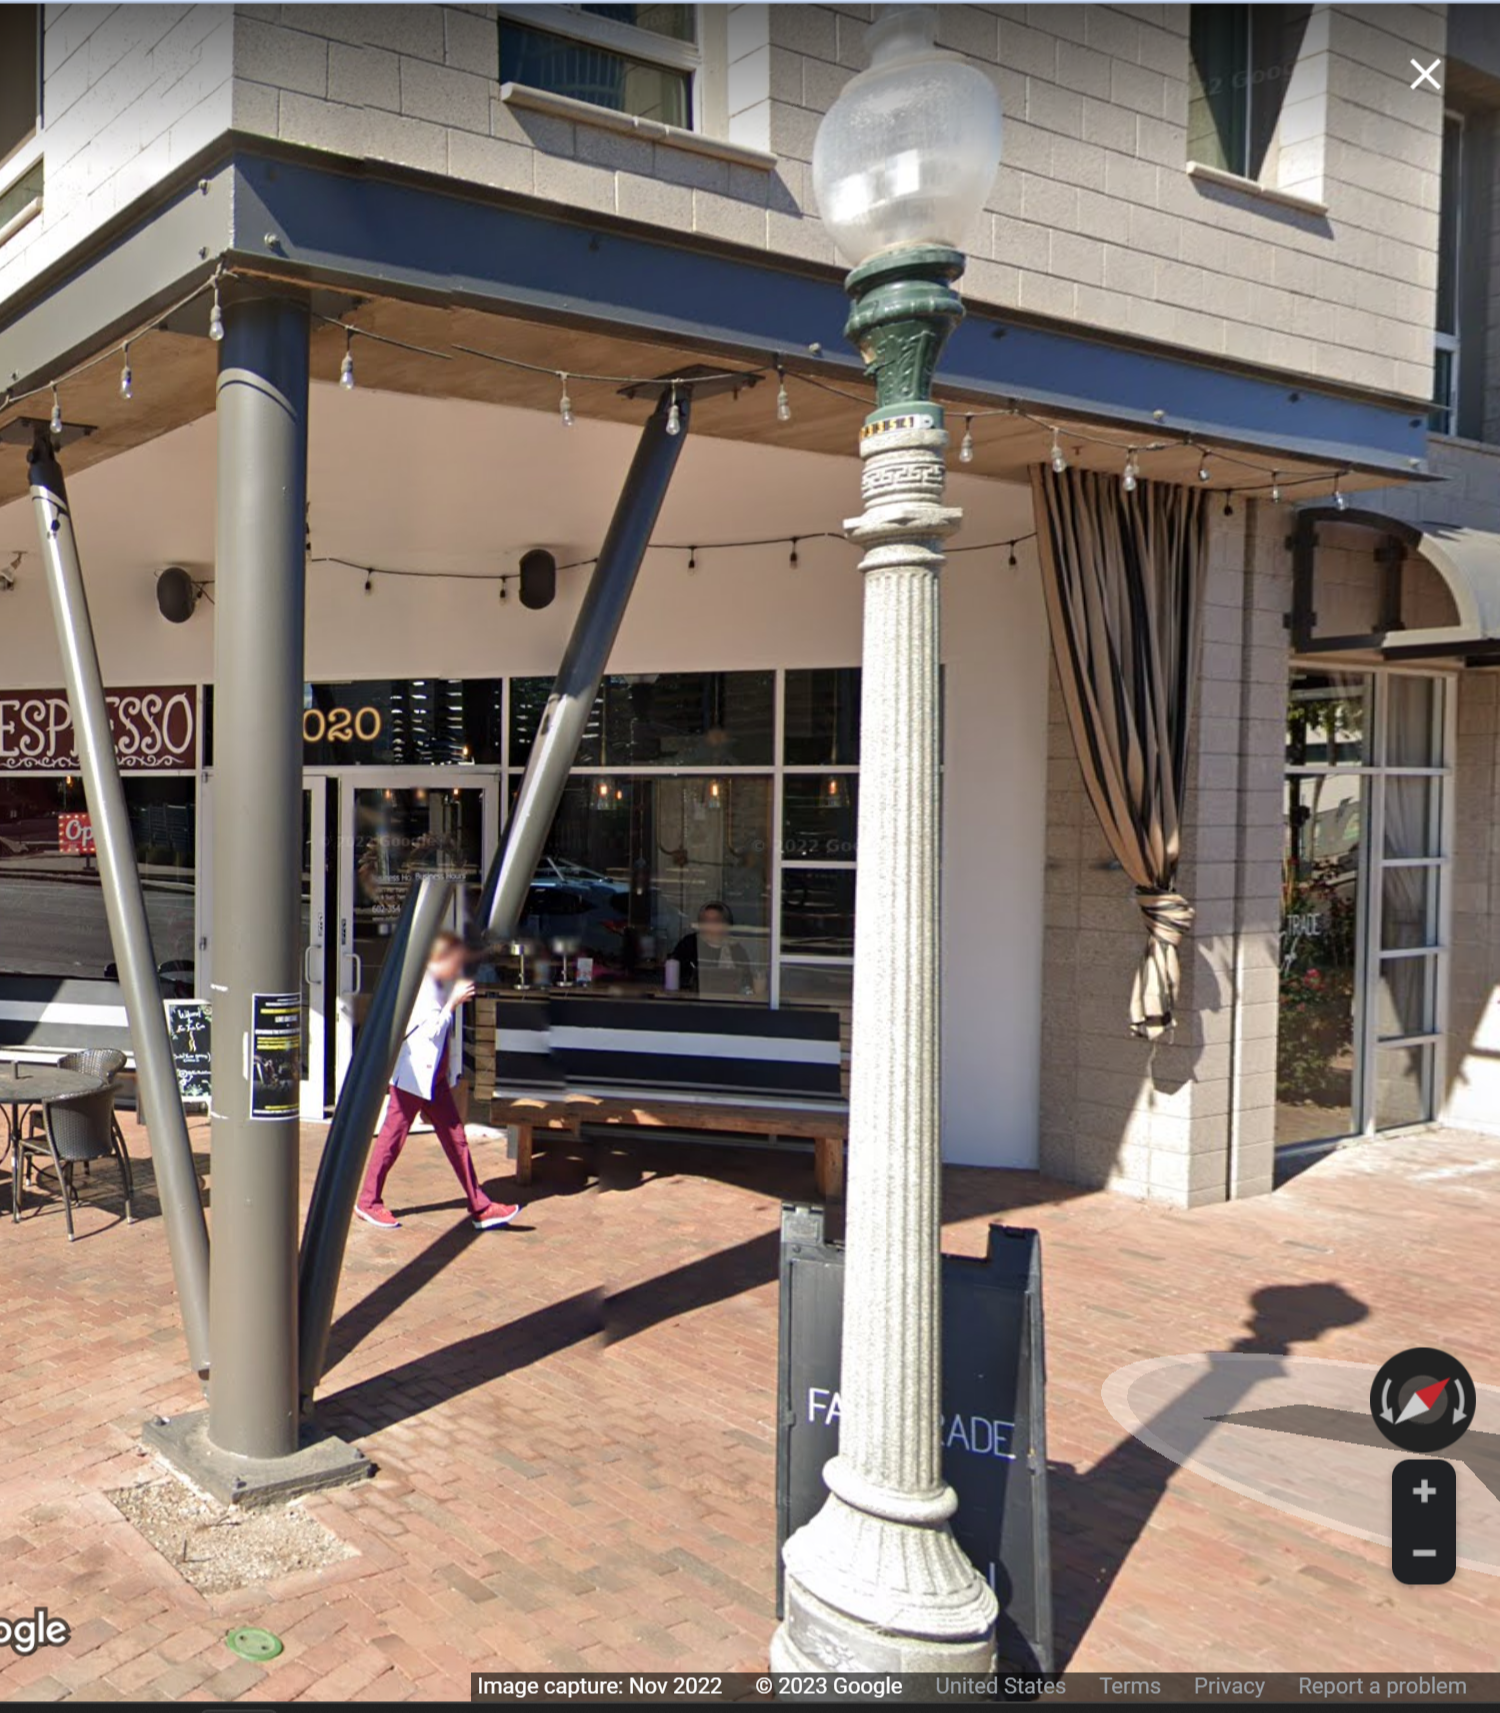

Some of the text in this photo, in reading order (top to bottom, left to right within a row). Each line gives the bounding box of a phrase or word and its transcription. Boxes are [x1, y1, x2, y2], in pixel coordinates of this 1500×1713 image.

[303, 706, 381, 743] 020
[64, 818, 95, 848] Op
[1287, 913, 1322, 936] TRADE
[808, 1387, 842, 1425] FA
[941, 1414, 1016, 1459] ADE
